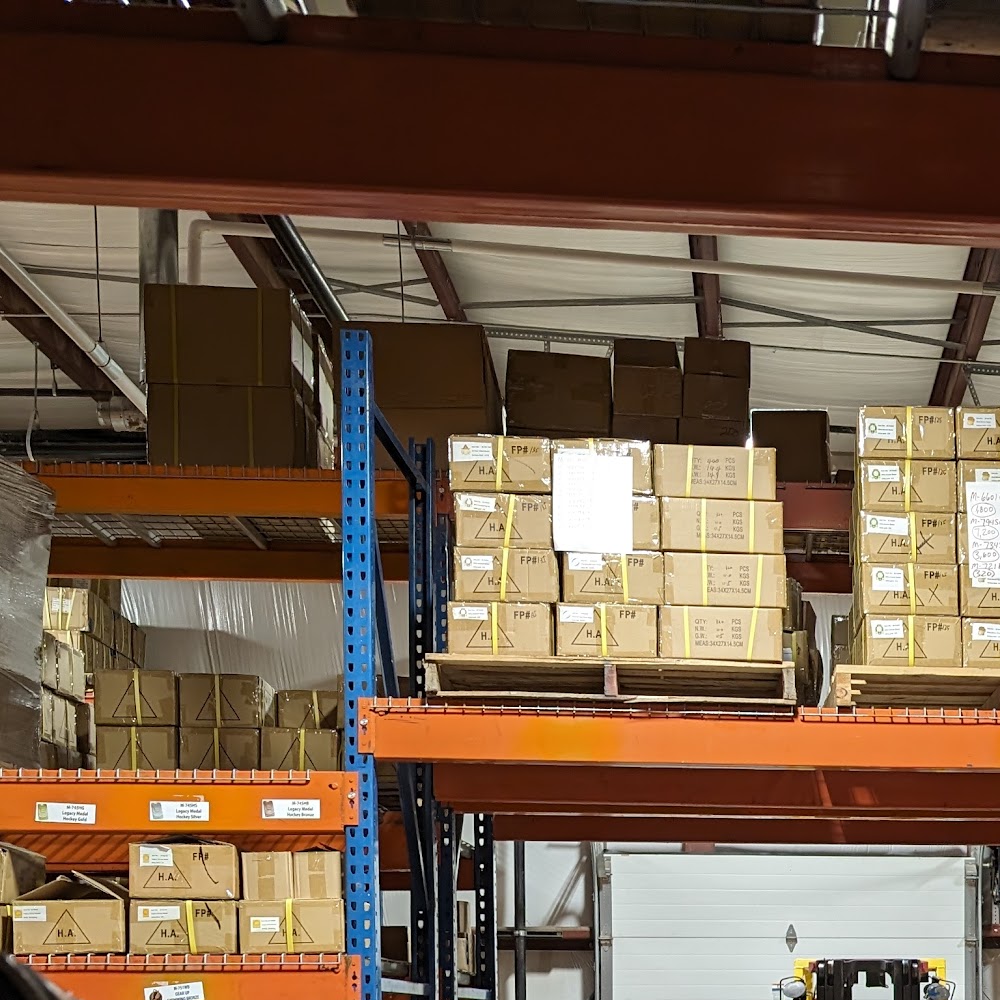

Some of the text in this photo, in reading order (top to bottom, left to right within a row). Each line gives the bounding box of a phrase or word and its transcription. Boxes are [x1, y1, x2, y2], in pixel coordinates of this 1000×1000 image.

[511, 445, 529, 454] FP#
[922, 466, 938, 475] FP#
[921, 519, 938, 528] FP#
[520, 555, 537, 565] FP#
[627, 558, 644, 567] FP#
[924, 570, 939, 579] FP#
[513, 610, 531, 620] FP#
[619, 610, 636, 619] FP#
[927, 623, 943, 631] FP#
[158, 872, 178, 881] H.A.
[57, 929, 77, 938] H.A.
[161, 929, 180, 938] H.A.
